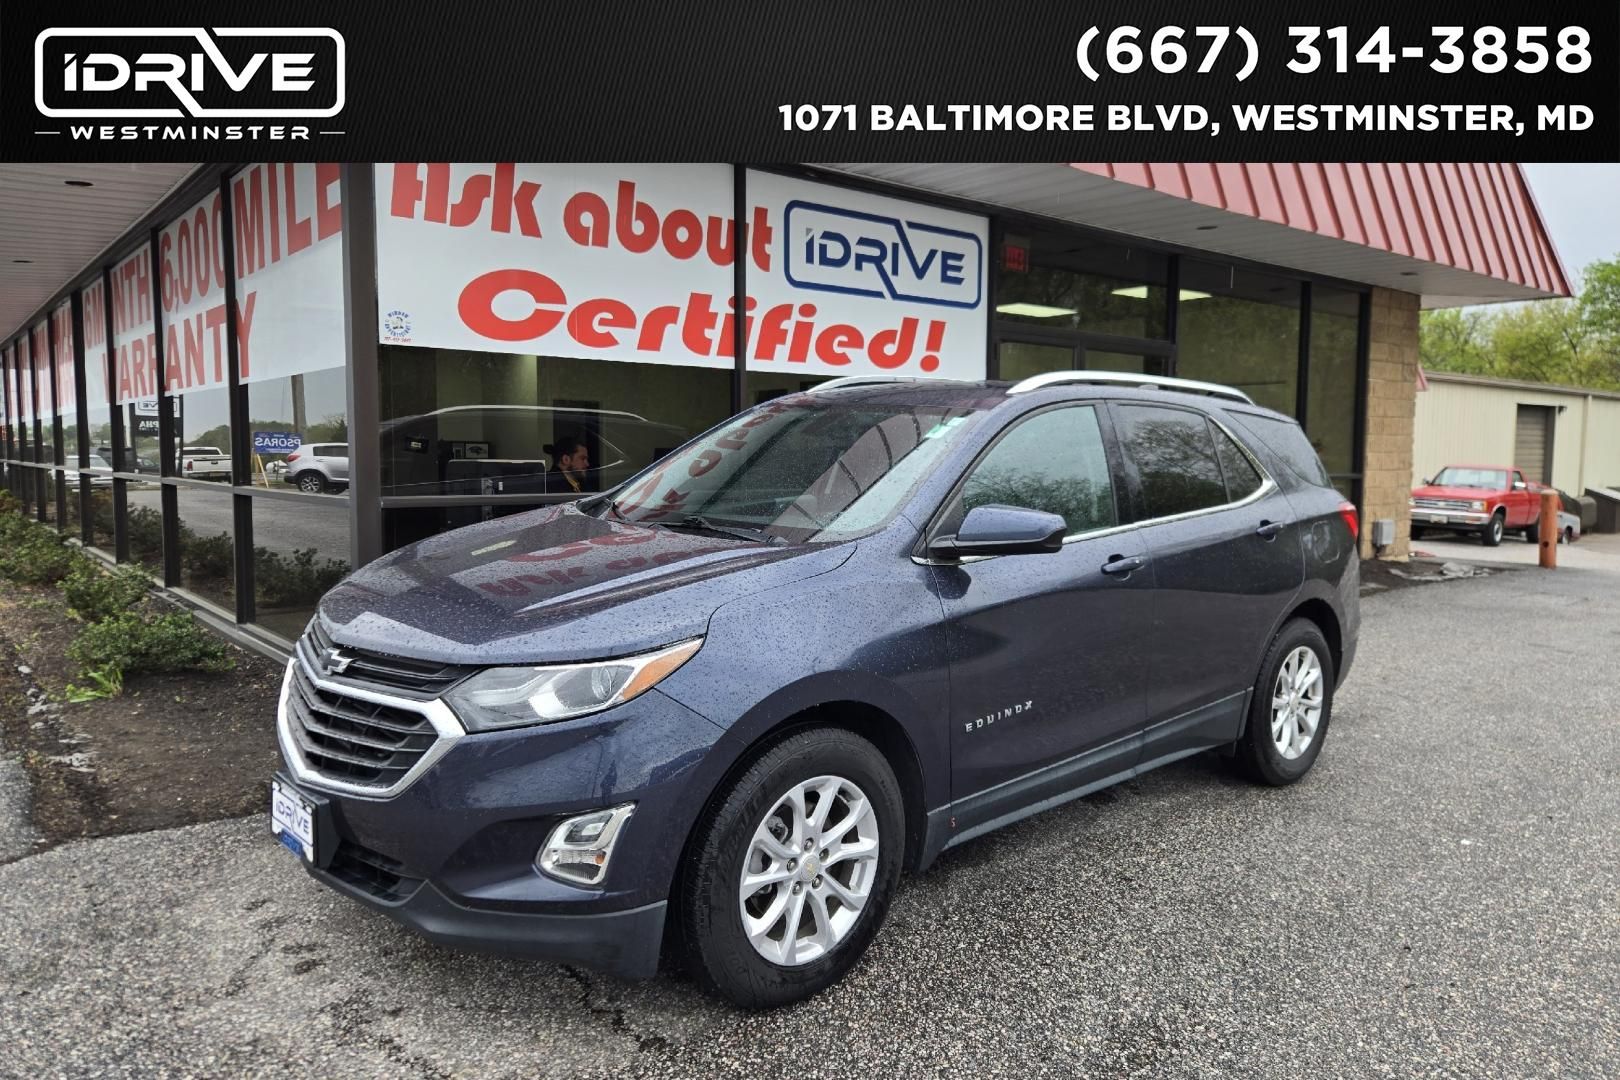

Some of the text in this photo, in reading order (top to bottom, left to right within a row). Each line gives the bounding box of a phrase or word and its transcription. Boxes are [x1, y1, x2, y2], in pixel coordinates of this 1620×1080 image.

[391, 163, 773, 273] Ask about
[457, 268, 946, 373] Certified!
[965, 700, 1033, 733] EQUINOX
